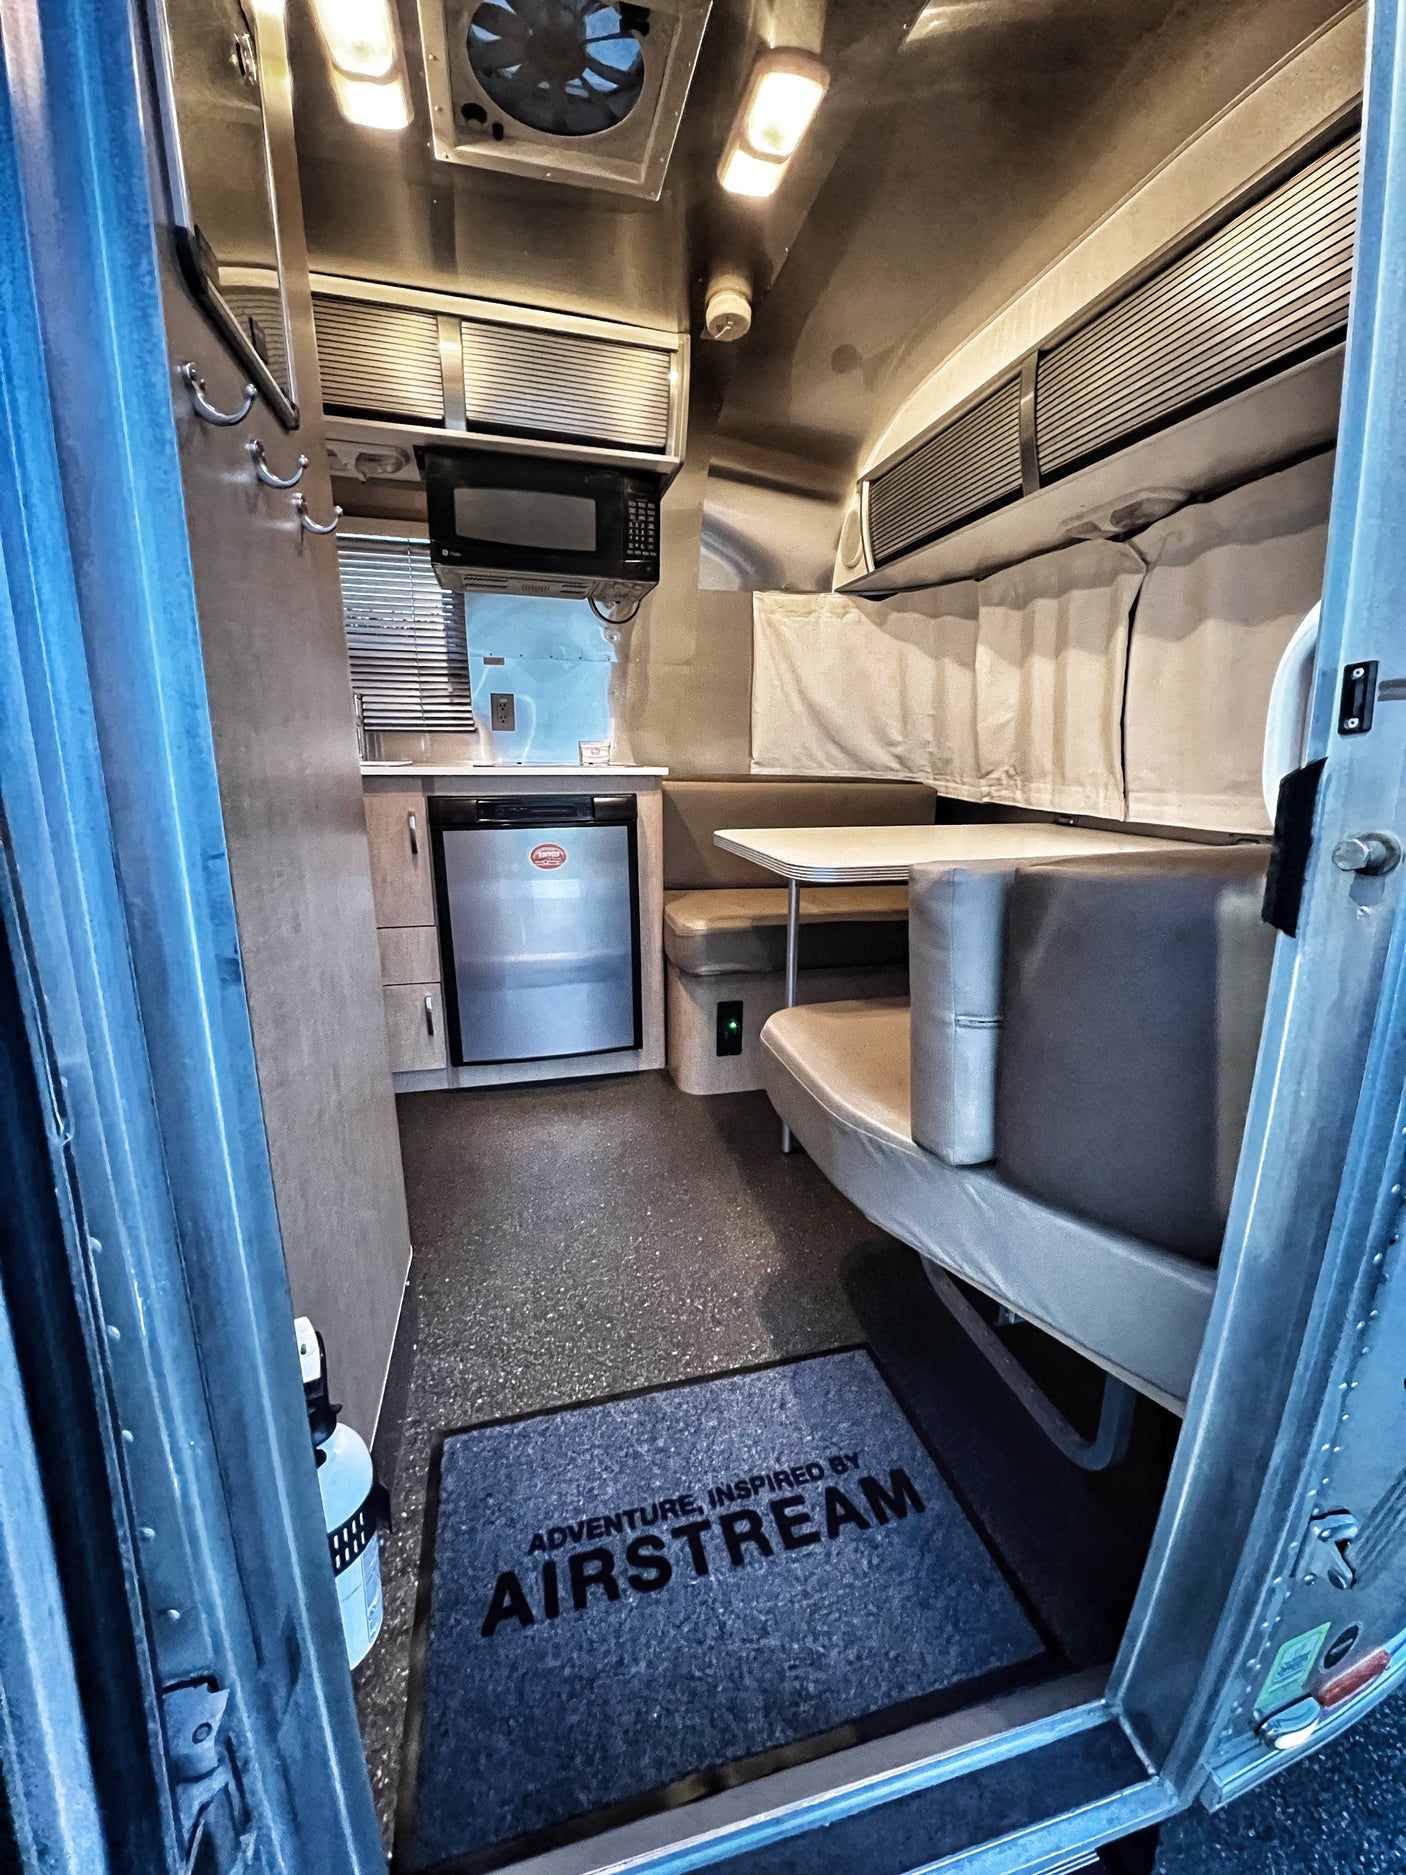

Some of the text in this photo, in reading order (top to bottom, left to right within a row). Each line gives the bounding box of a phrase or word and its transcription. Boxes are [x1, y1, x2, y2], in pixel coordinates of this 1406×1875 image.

[707, 1462, 824, 1509] INSPIRED
[828, 1452, 861, 1475] BY
[481, 1468, 926, 1637] AIRSTREAM
